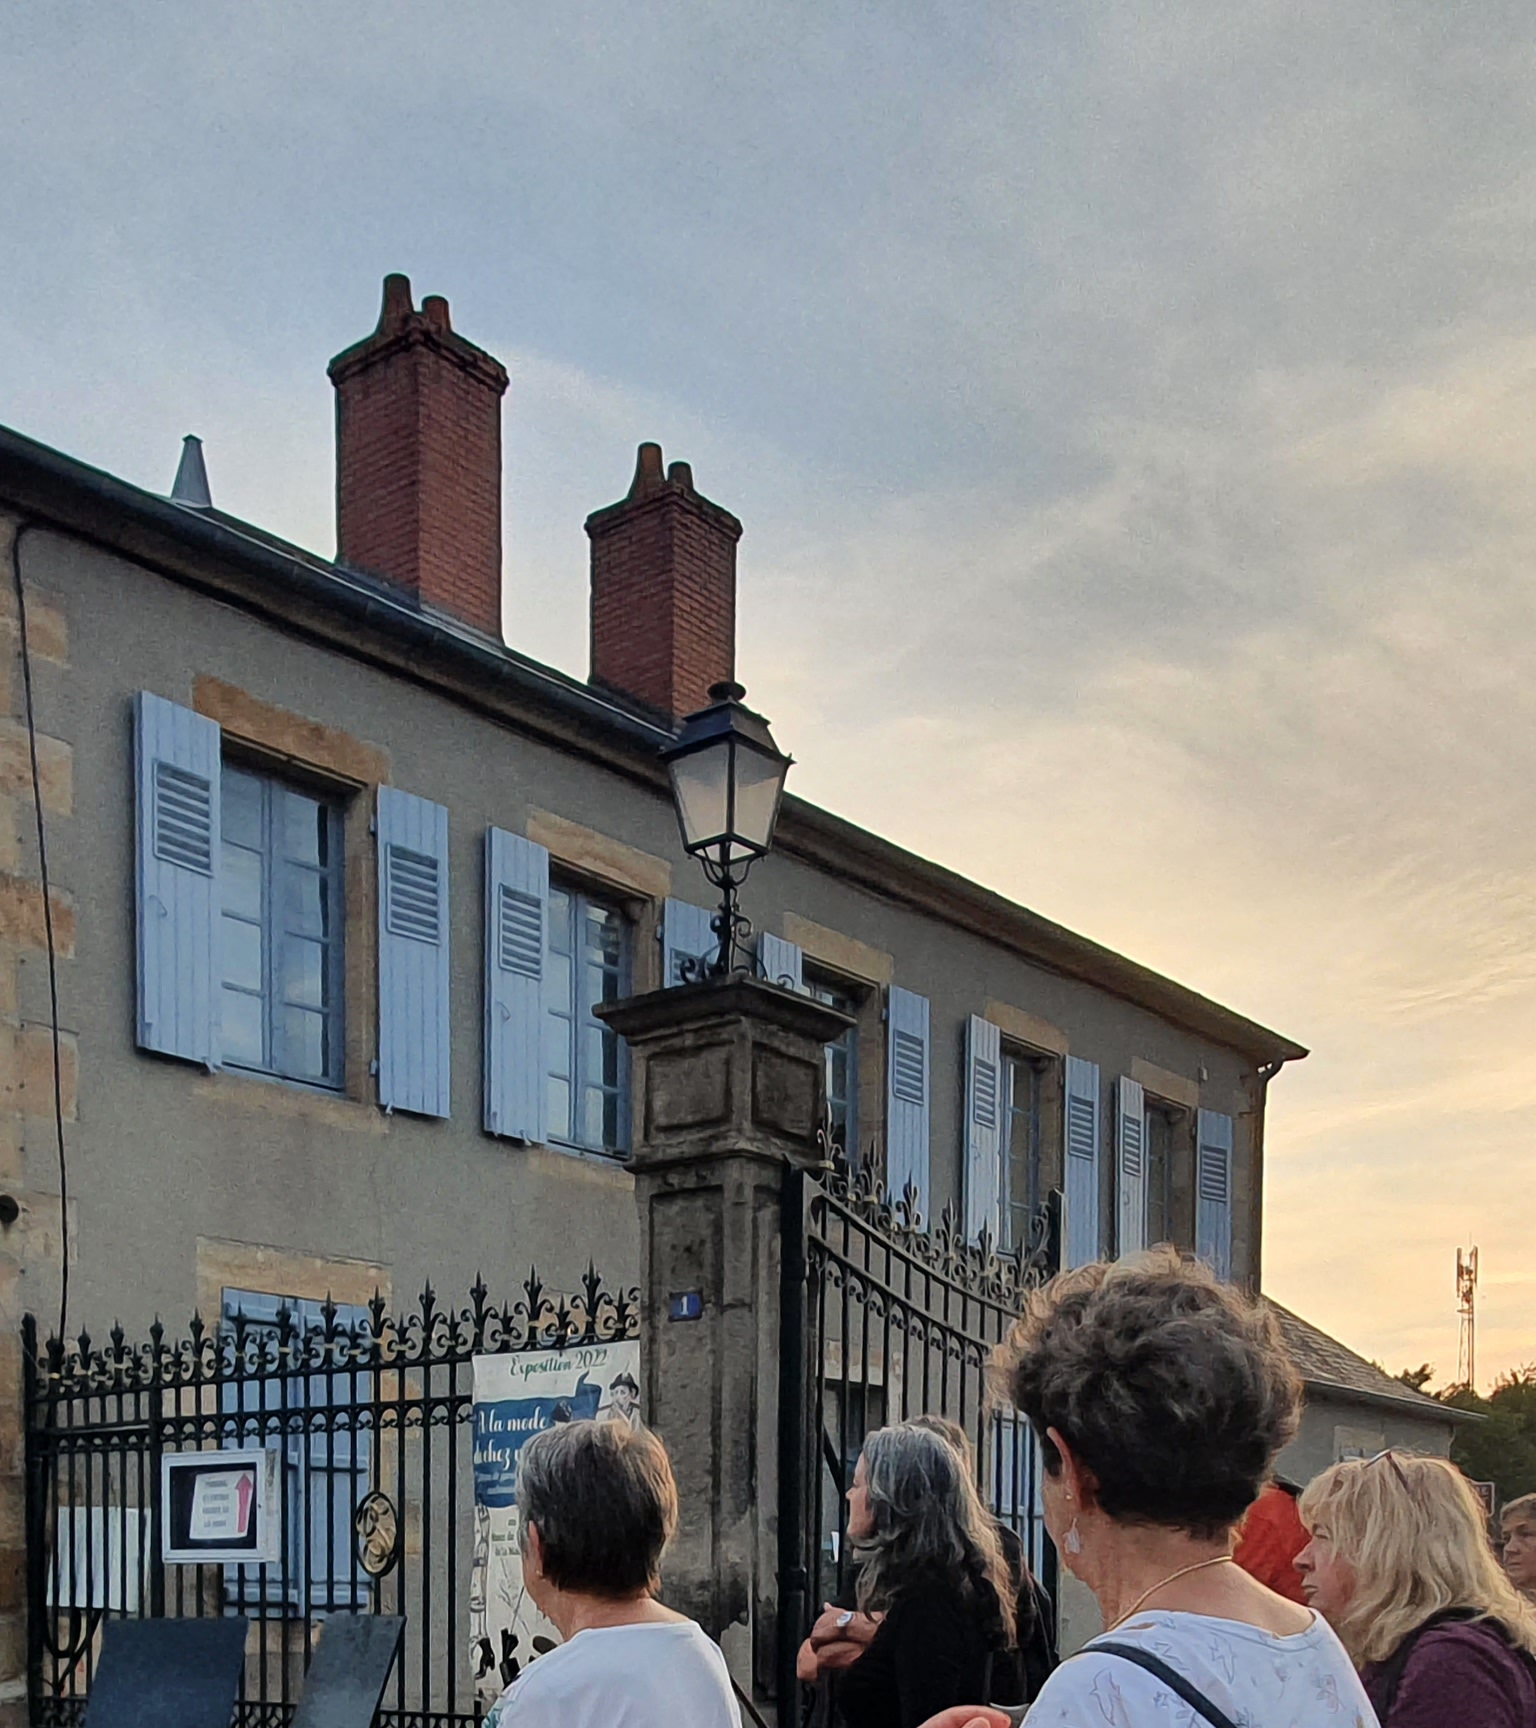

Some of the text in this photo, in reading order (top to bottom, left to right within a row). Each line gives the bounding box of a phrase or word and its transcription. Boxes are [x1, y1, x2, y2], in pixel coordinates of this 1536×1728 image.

[680, 1295, 689, 1316] 1
[510, 1348, 607, 1382] Exposition 2022
[489, 1408, 504, 1433] la
[507, 1405, 547, 1432] mode
